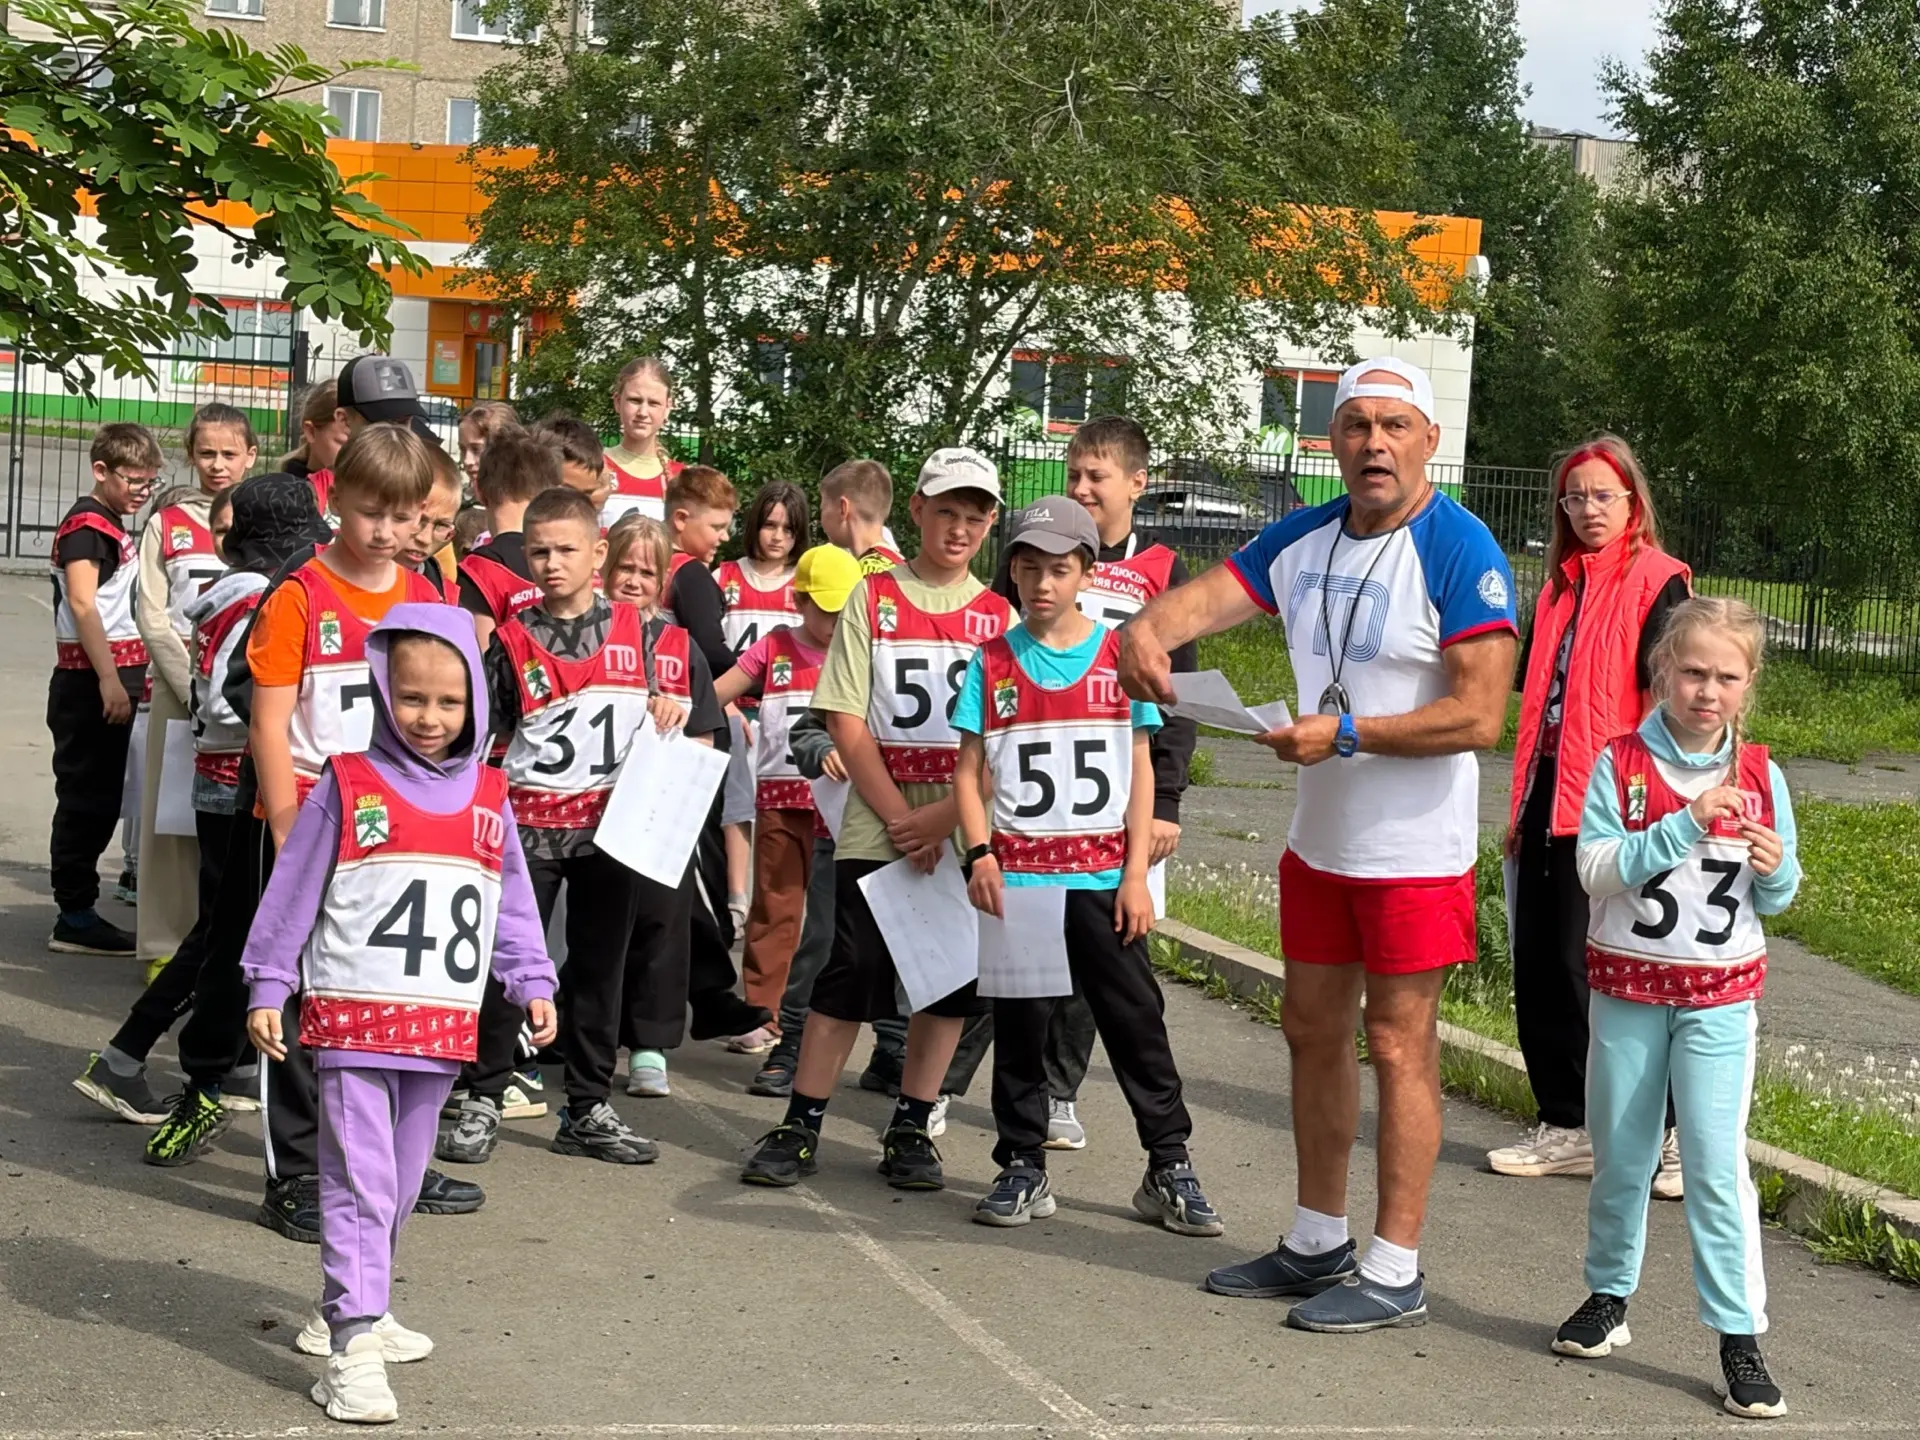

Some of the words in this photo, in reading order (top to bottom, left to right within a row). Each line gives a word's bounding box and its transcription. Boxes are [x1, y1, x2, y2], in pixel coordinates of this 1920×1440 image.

[1024, 507, 1050, 521] FILA
[965, 609, 1001, 639] ГТО
[604, 644, 638, 673] ГТО
[655, 654, 684, 681] ТО
[533, 703, 621, 776] 31
[1014, 740, 1110, 818] 55
[472, 804, 504, 849] ГТО
[1631, 858, 1742, 946] 33
[365, 879, 482, 984] 48
